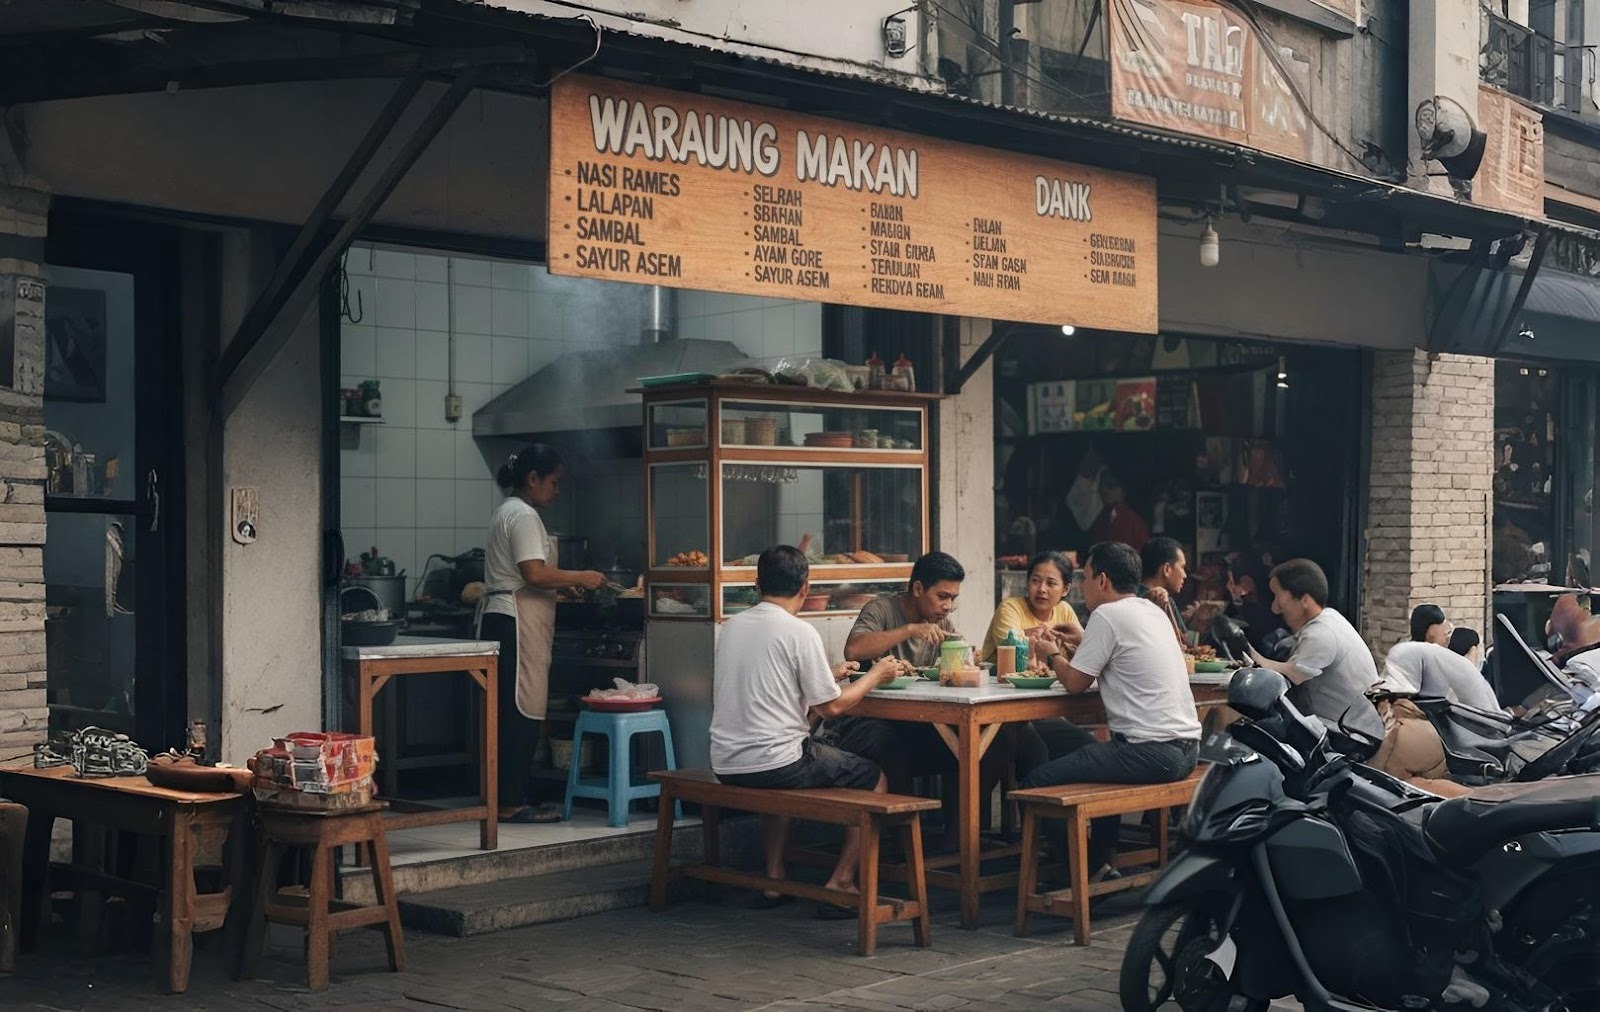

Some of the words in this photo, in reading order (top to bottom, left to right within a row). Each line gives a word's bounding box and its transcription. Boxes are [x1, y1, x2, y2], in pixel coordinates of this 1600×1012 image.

[589, 94, 780, 178] WARAUNG
[794, 129, 919, 199] MAKAN
[1034, 175, 1093, 223] DANK
[577, 160, 617, 188] NASI
[623, 166, 681, 197] RAMES
[577, 188, 653, 220] LALAPAN
[576, 216, 646, 246] SAMBAL
[753, 224, 804, 246] SAMBAL
[576, 244, 631, 273] SAYUR
[636, 251, 682, 278] ASEM
[753, 244, 787, 264] AYAM
[791, 248, 823, 269] GORE
[754, 264, 793, 285] SAYUR
[796, 269, 830, 289] ASEM
